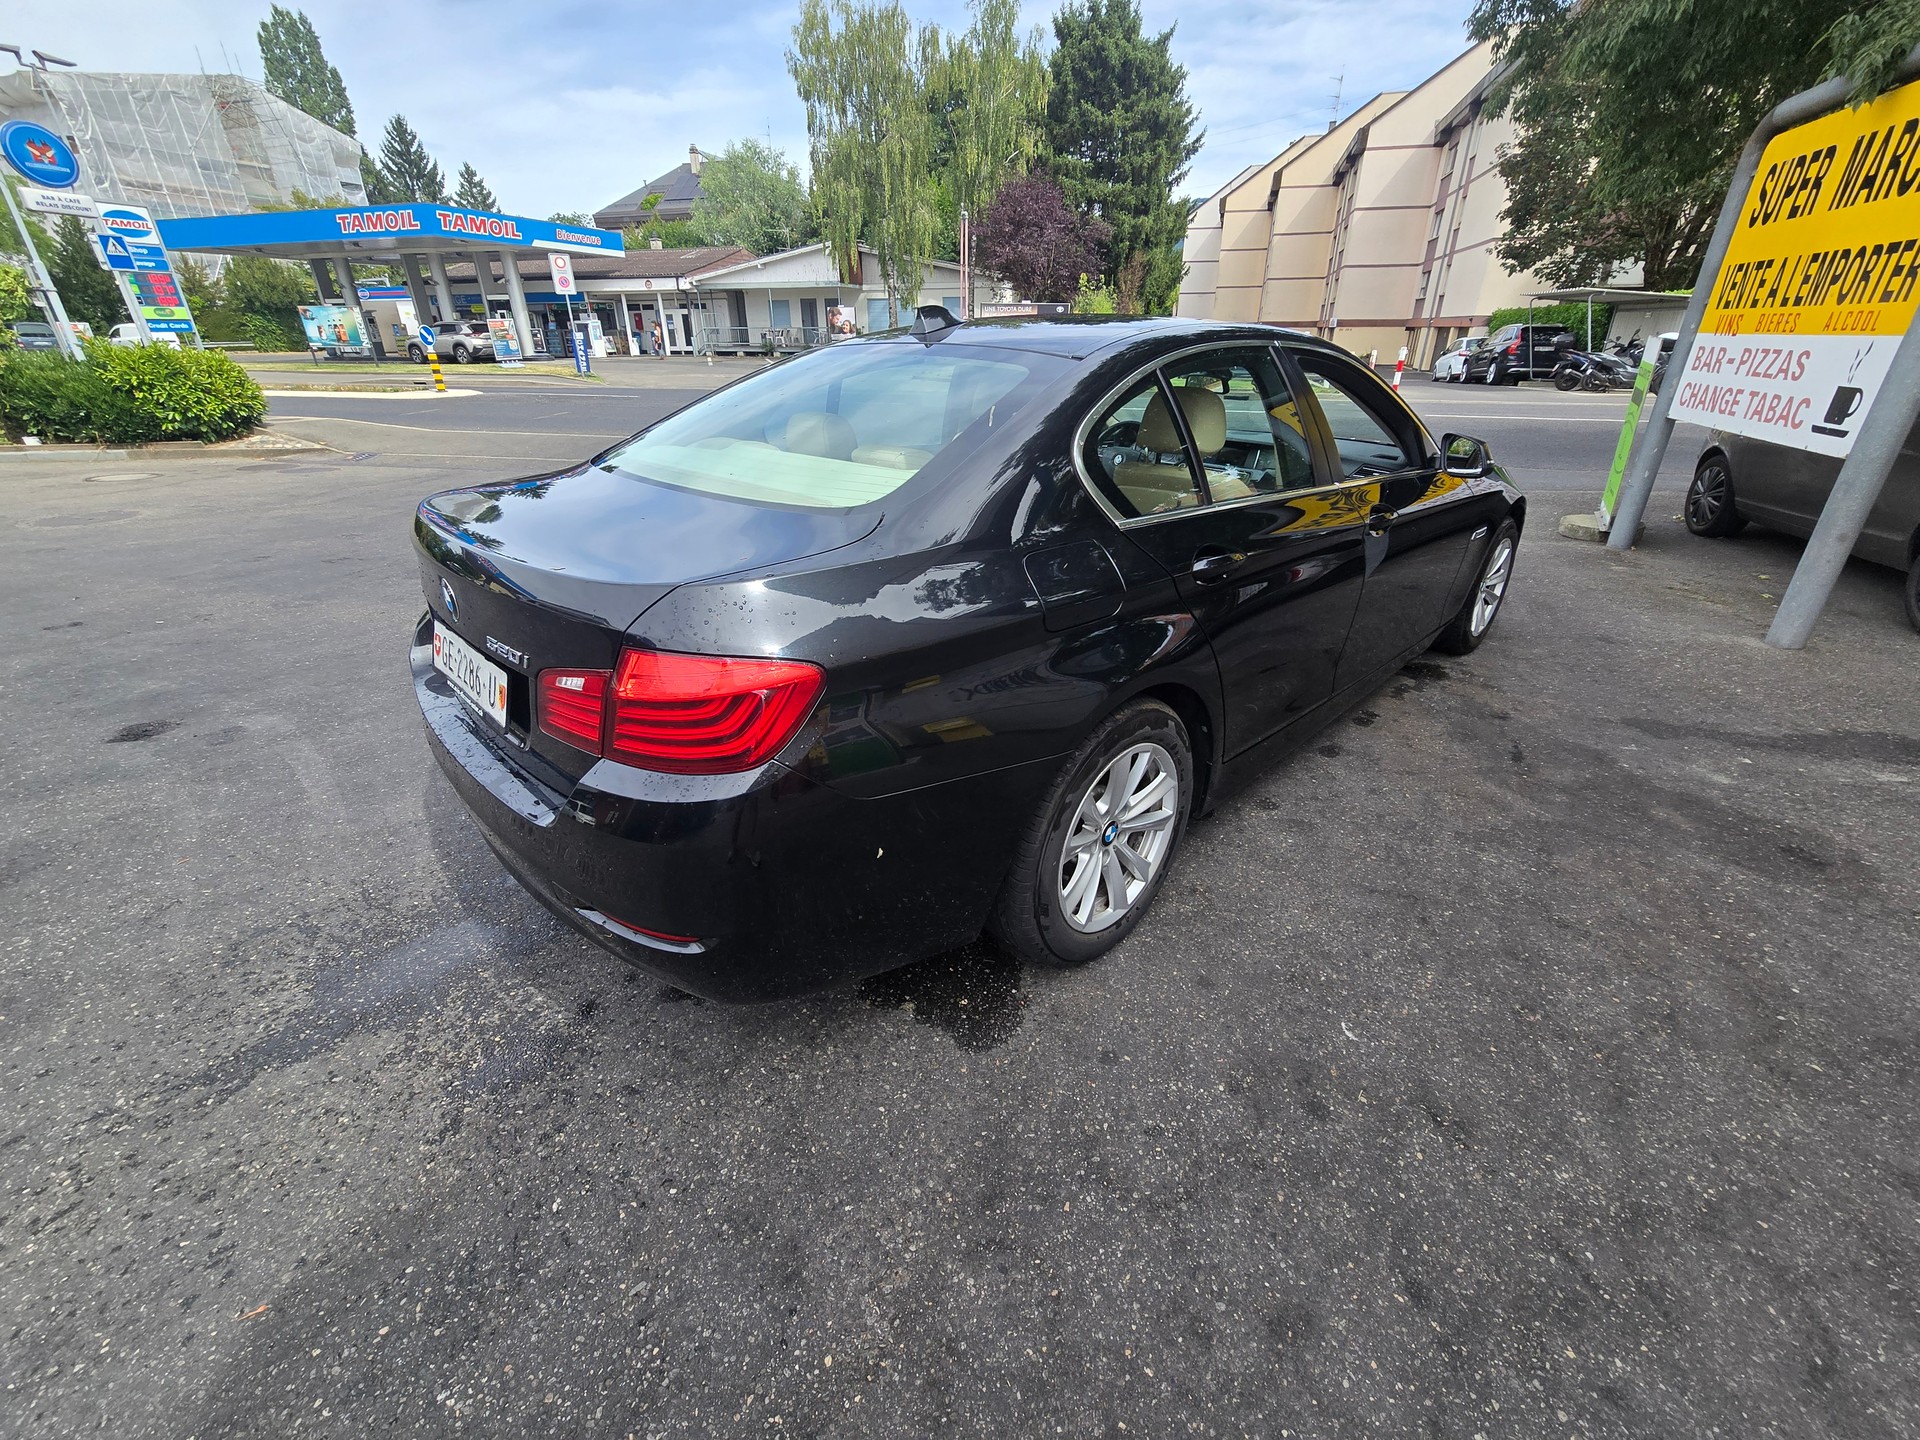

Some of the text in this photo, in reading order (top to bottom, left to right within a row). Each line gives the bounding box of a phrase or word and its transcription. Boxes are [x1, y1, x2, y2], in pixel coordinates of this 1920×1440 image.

[1748, 117, 1920, 229] SUPER MARC
[35, 200, 93, 213] RELAIS DISCOUNT
[102, 218, 153, 230] TAMOIL
[336, 210, 522, 240] TAMOIL TAMOIL
[556, 229, 602, 245] Bienvenue
[1716, 258, 1775, 310] VENTE
[1762, 256, 1788, 308] A
[1714, 310, 1881, 337] VINS BIERES ALCOOL
[1679, 382, 1811, 430] CHANGE TABAC
